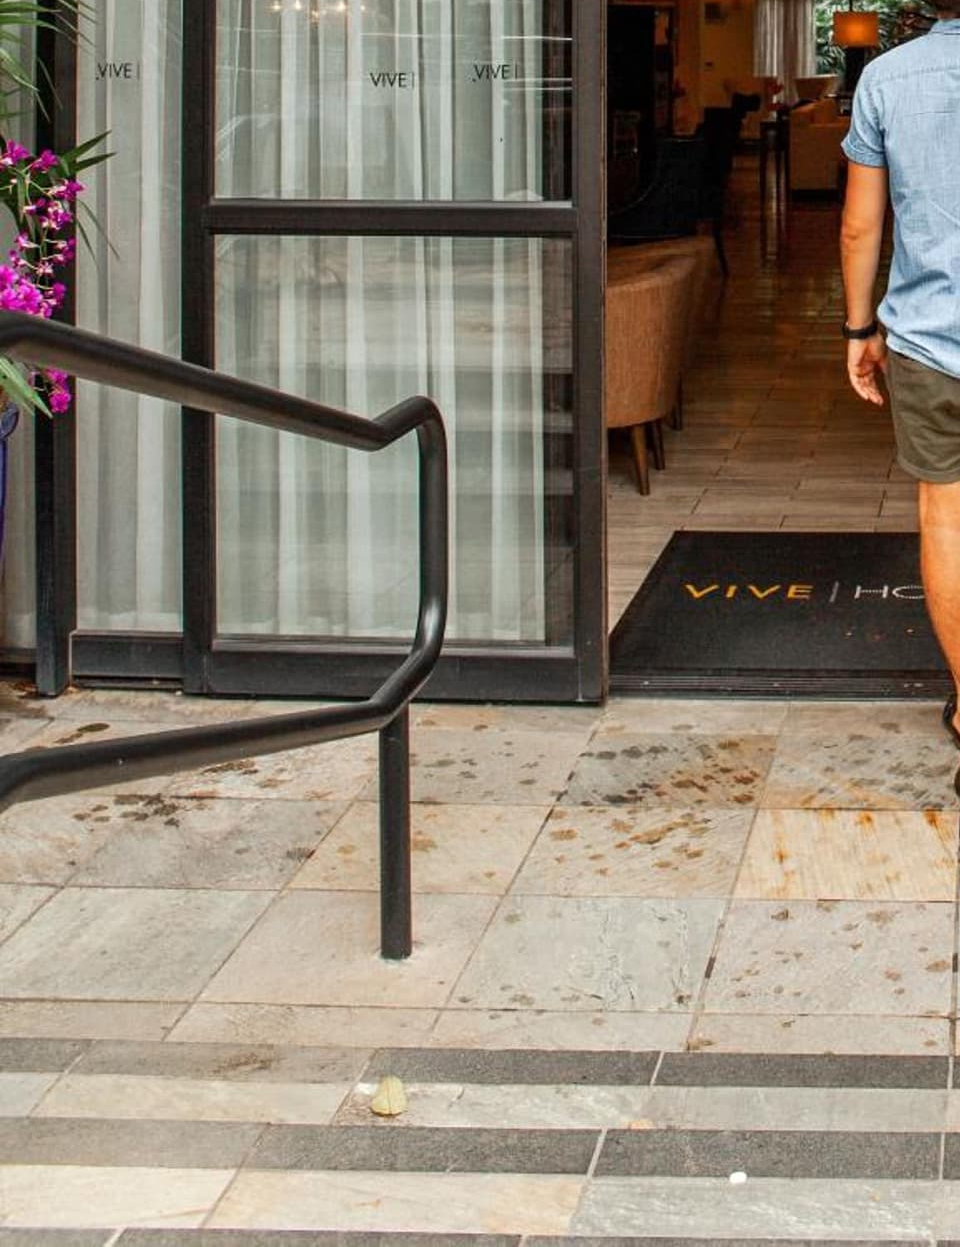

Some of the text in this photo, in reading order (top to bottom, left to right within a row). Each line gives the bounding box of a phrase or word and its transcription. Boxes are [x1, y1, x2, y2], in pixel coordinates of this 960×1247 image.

[97, 62, 132, 79] VIVE
[473, 63, 510, 80] VIVE
[370, 72, 407, 88] VIVE
[684, 584, 814, 599] VIVE
